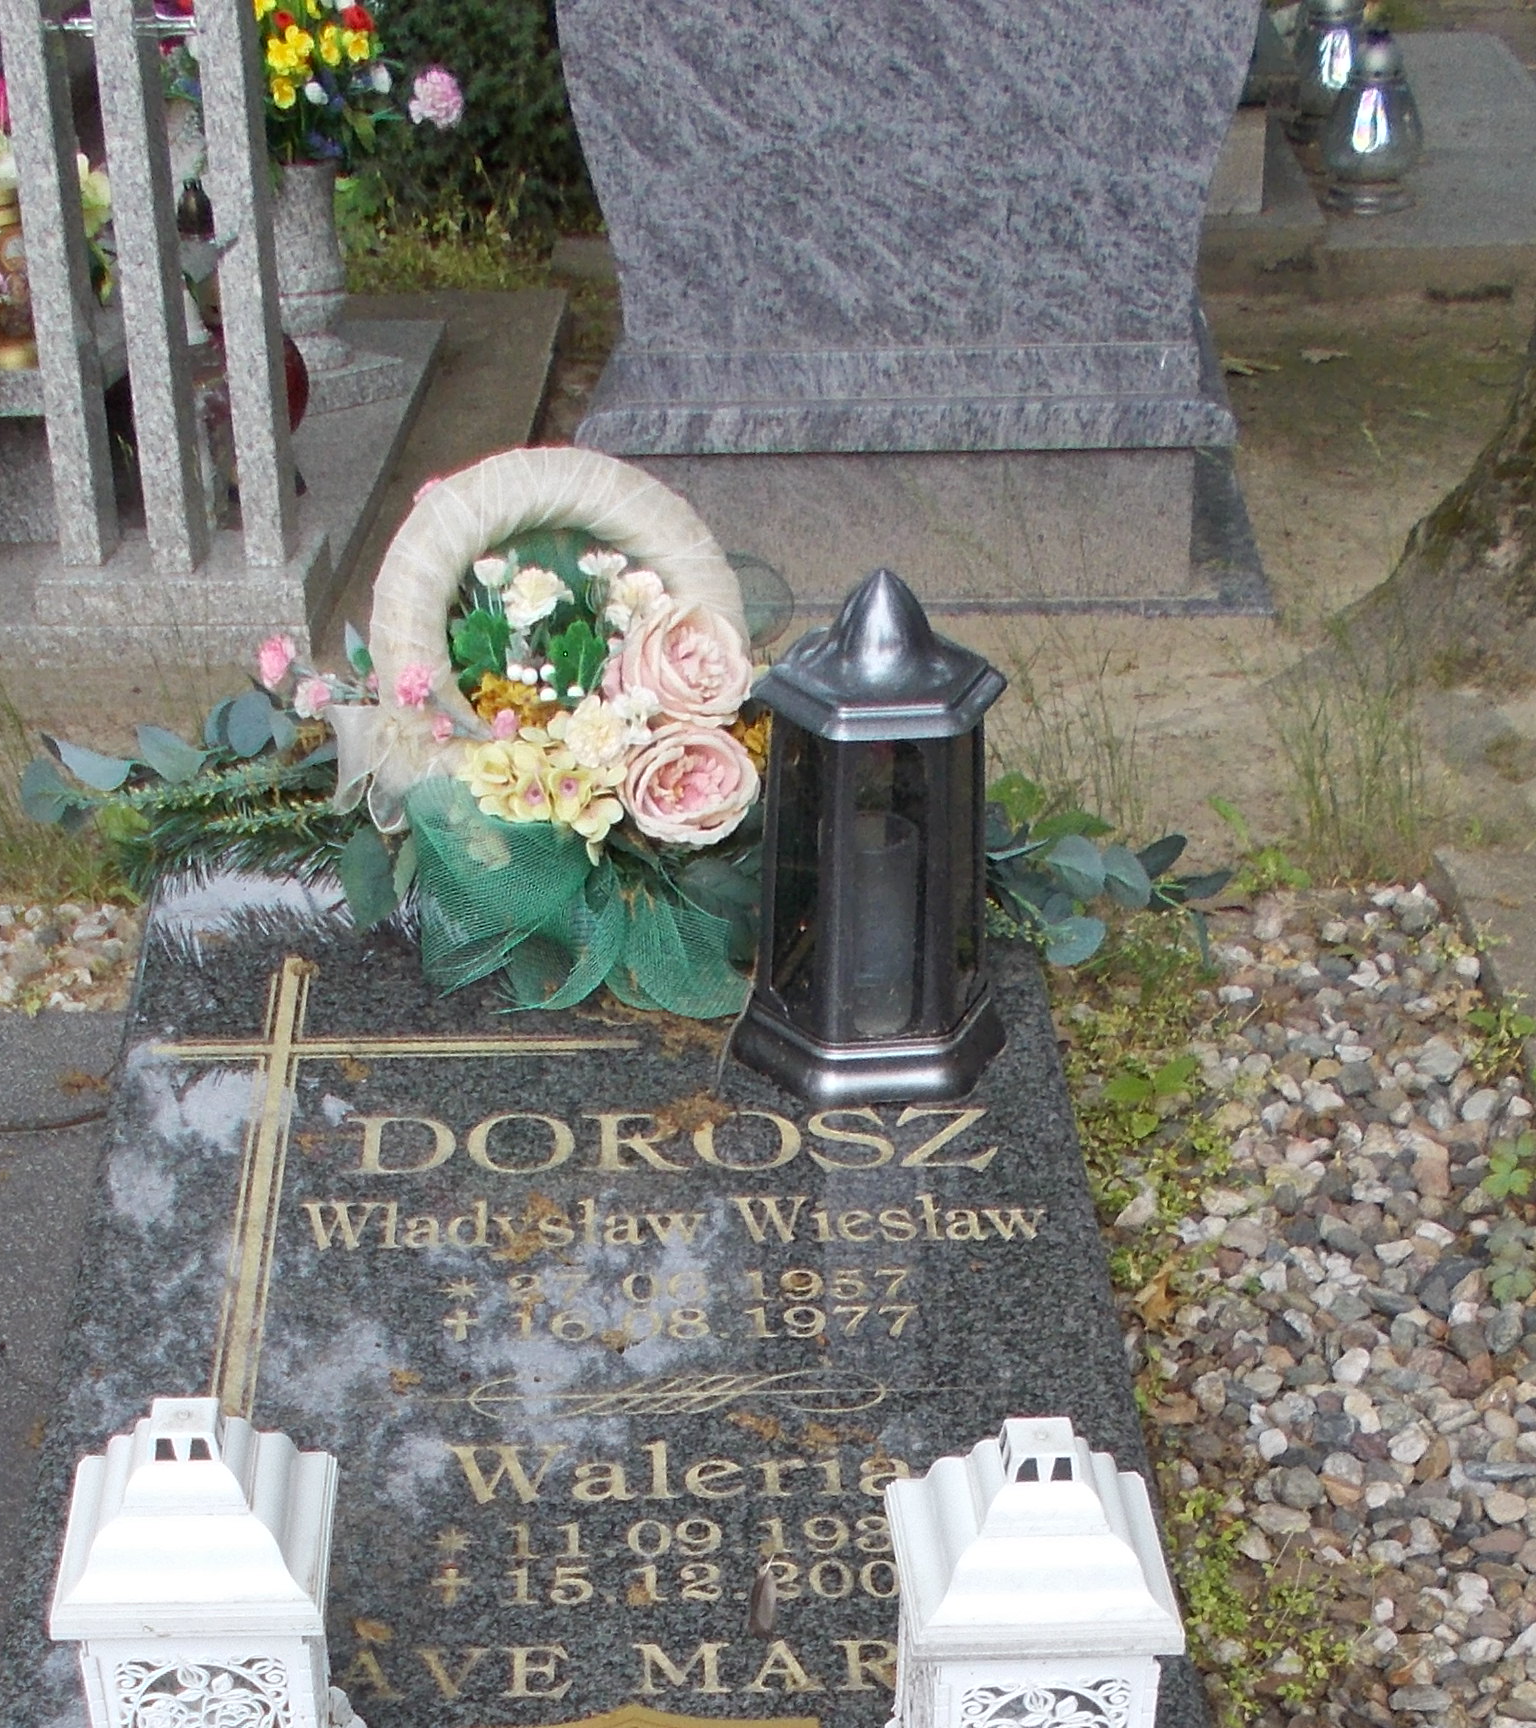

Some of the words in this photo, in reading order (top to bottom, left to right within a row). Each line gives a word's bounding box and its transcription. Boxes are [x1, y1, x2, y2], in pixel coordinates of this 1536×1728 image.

[344, 1106, 999, 1175] DOROSZ
[729, 1194, 1046, 1243] Wiesław
[444, 1438, 910, 1504] Waleria
[506, 1515, 896, 1560] 11.09.193
[504, 1559, 901, 1605] 15.12.200
[341, 1644, 574, 1700] AVE
[630, 1639, 897, 1694] MAR
